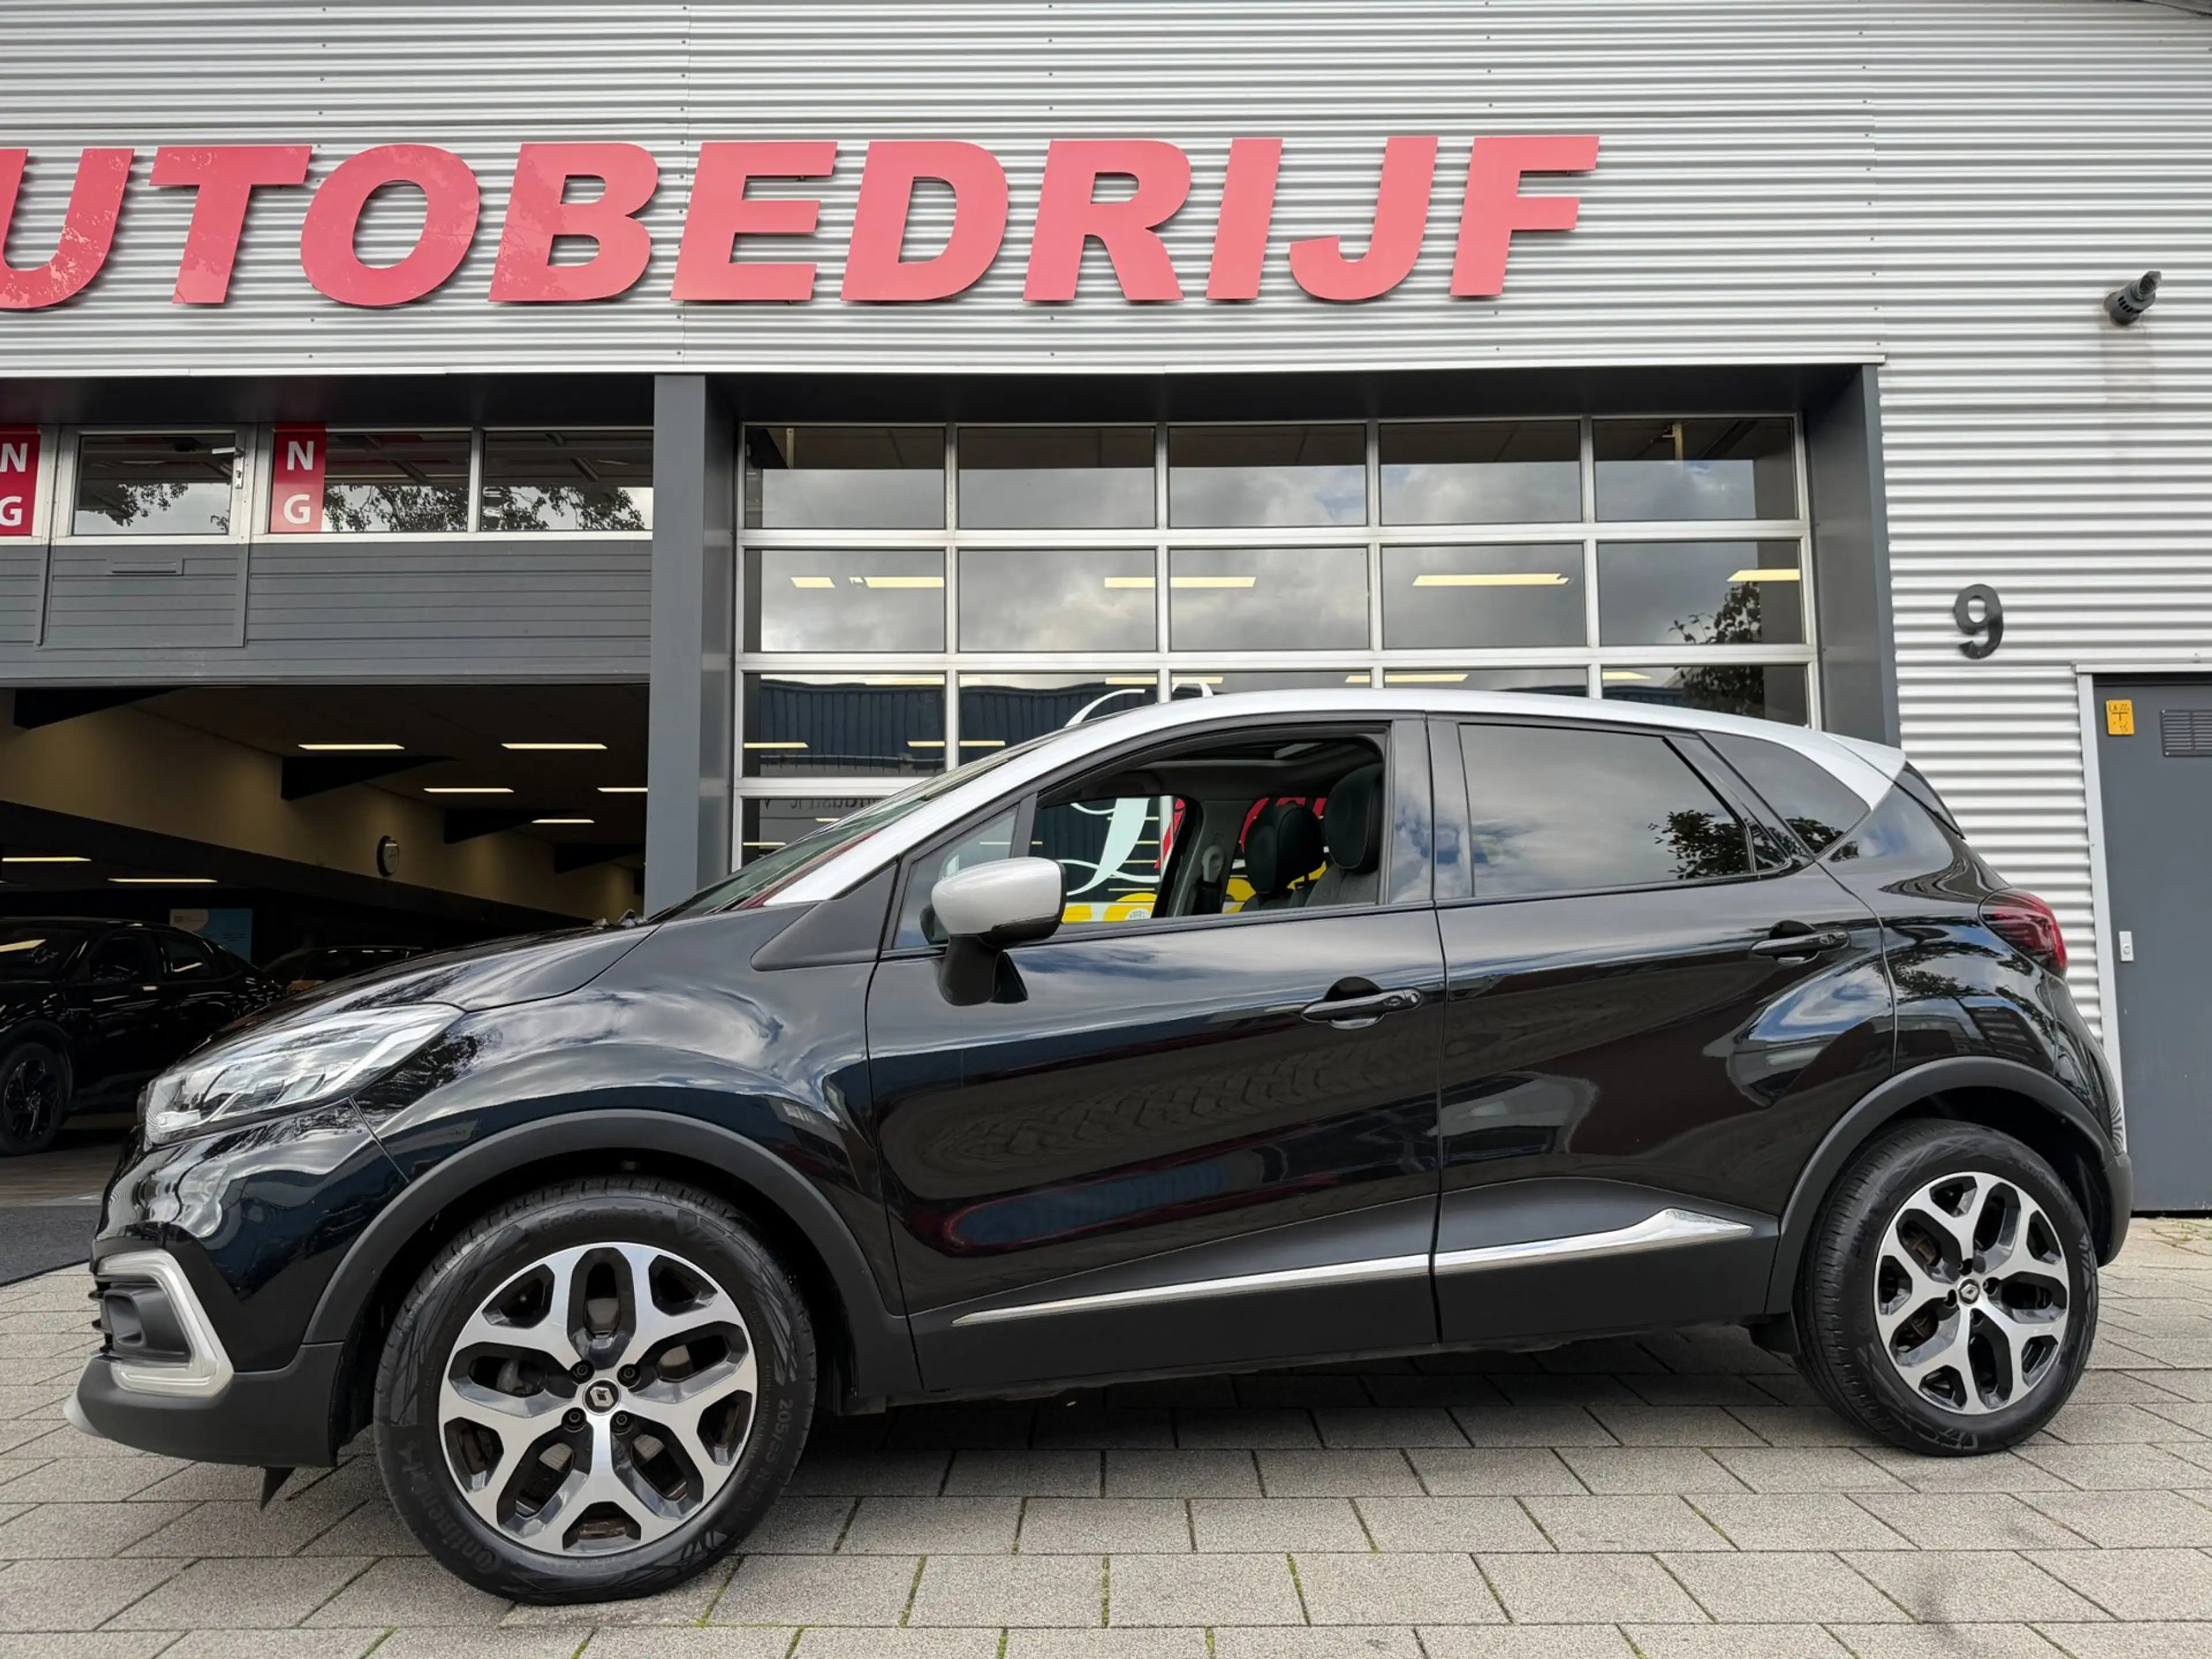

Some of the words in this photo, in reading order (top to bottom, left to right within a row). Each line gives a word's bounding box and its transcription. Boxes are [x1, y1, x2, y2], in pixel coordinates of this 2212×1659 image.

[0, 135, 1600, 309] UTOBEDRIJF
[0, 442, 28, 472] N
[287, 441, 315, 471] N
[0, 495, 22, 527] G
[283, 494, 310, 524] G
[1952, 584, 2004, 660] 9
